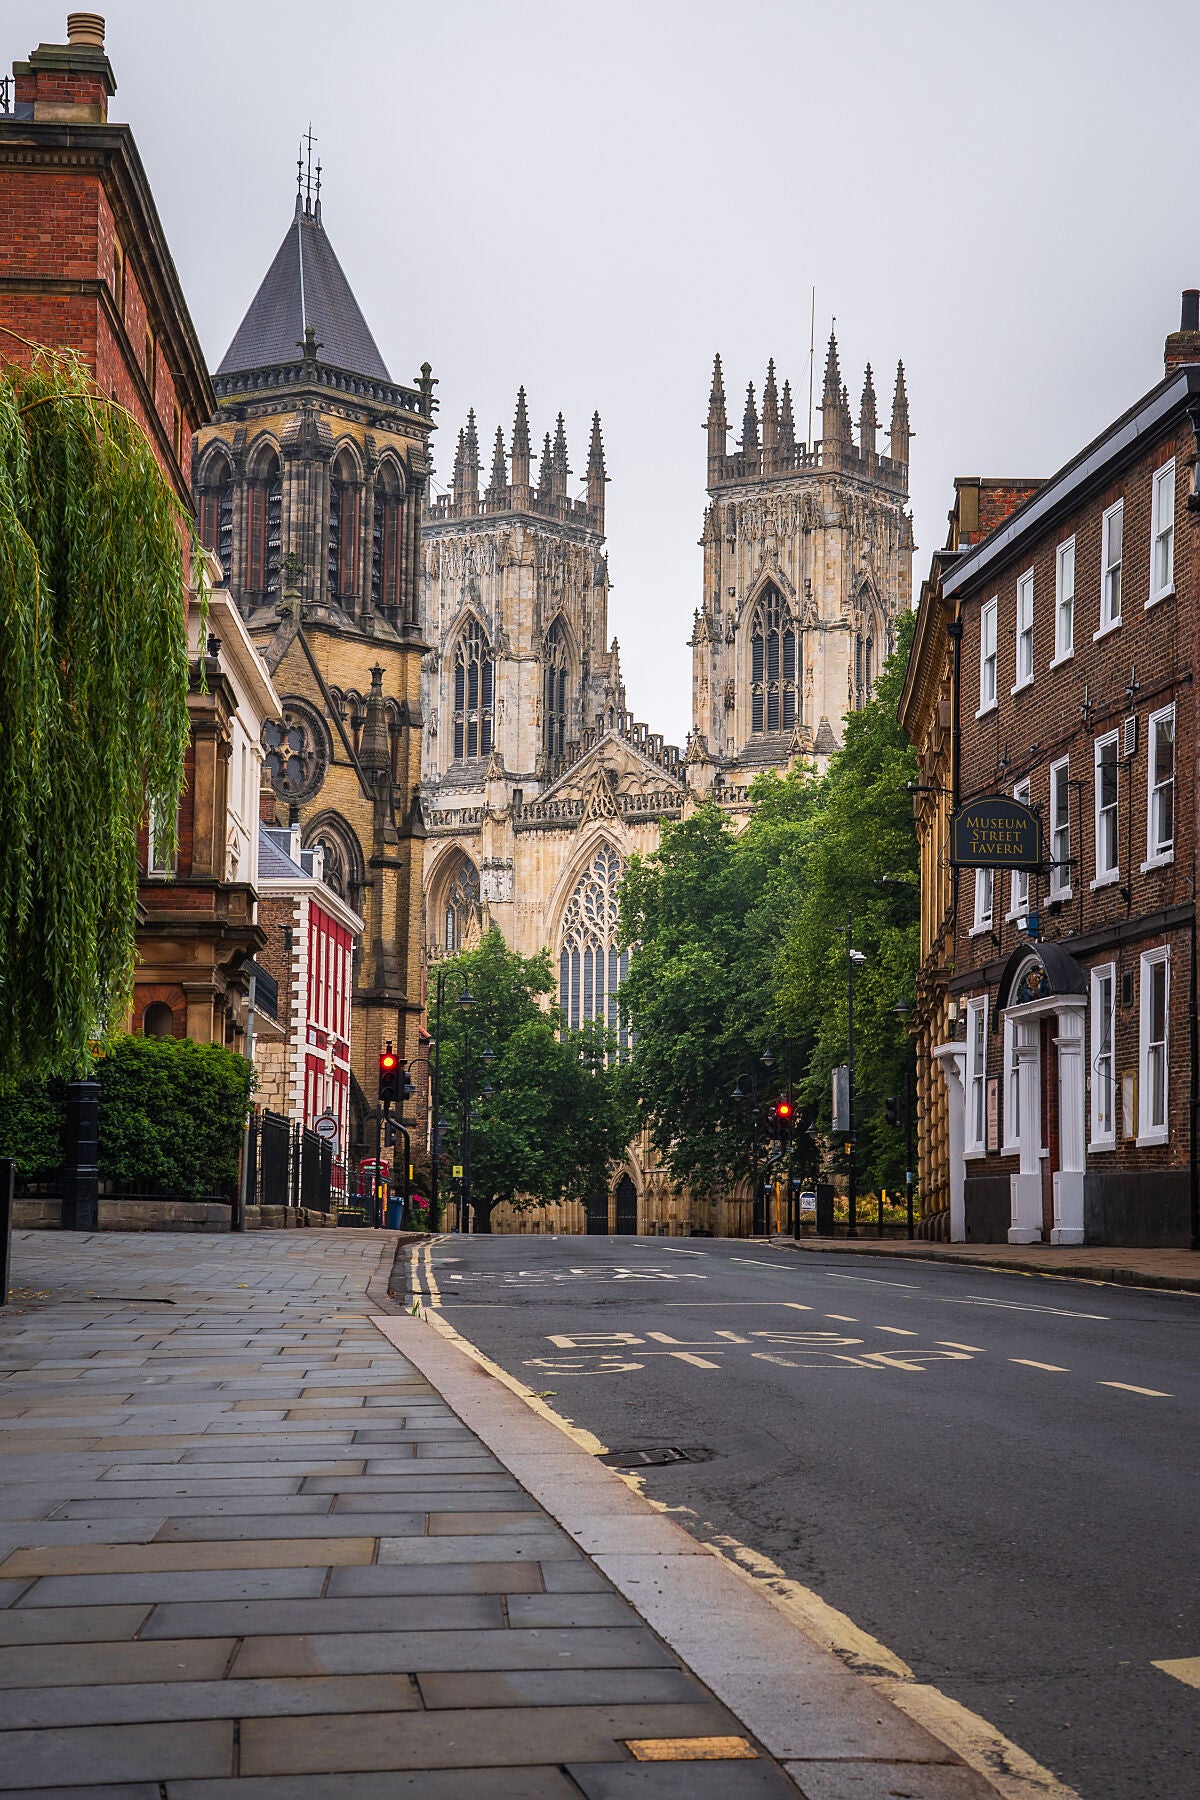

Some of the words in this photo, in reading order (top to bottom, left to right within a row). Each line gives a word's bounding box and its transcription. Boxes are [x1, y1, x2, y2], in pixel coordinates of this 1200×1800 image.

[966, 817, 1027, 829] MUSEUM
[972, 829, 1021, 842] STREET
[970, 841, 1023, 854] TAVERN
[543, 1330, 865, 1349] BUS
[521, 1350, 976, 1376] STOP
